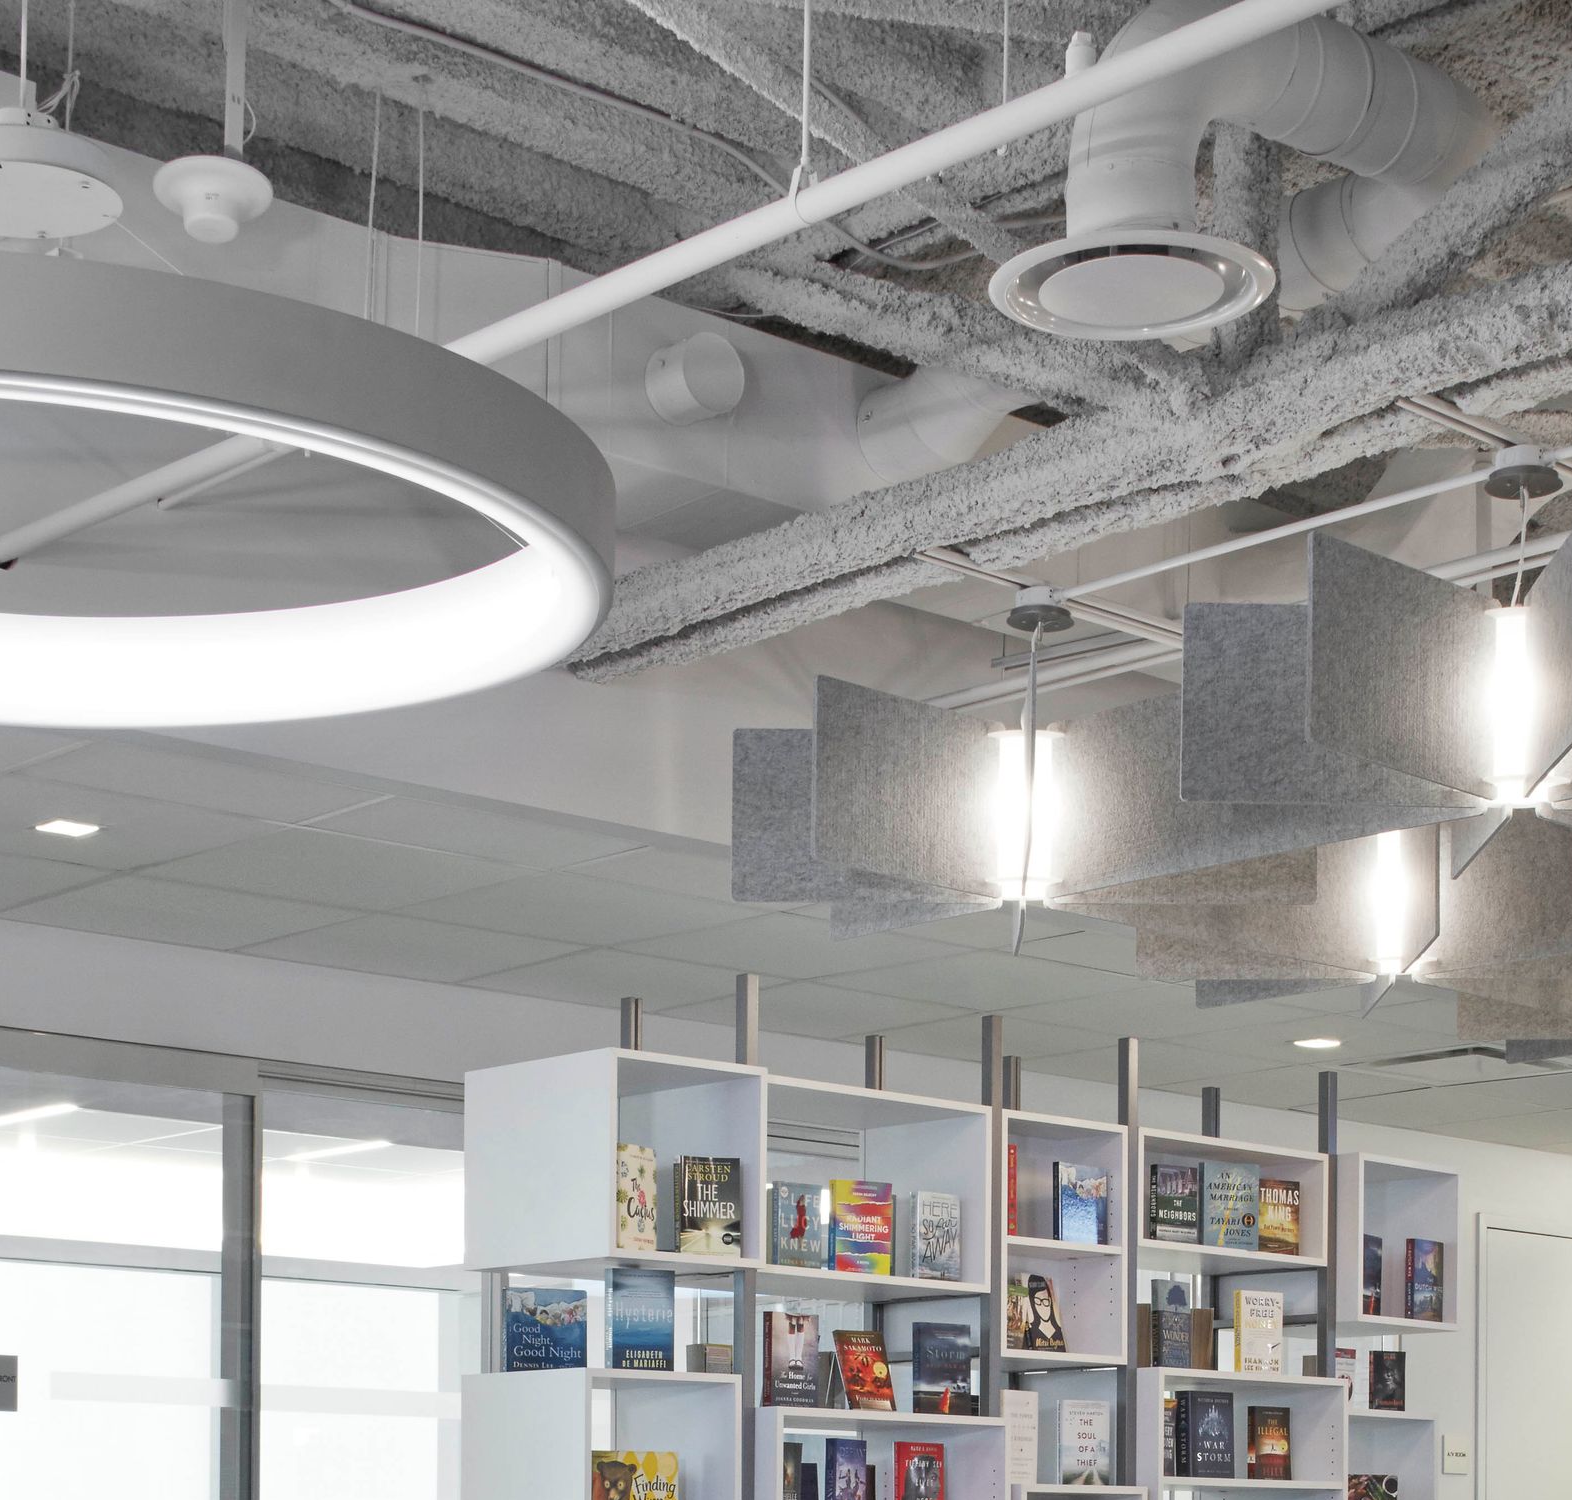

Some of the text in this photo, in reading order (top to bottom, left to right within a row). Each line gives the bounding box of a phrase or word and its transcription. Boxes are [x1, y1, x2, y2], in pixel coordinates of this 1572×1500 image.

[686, 1163, 731, 1174] CARSTEN
[687, 1172, 729, 1182] STROUD
[697, 1183, 718, 1201] THE
[1207, 1182, 1253, 1192] AMERICAN
[1210, 1193, 1254, 1203] MARRIAGE
[1260, 1187, 1300, 1206] THOMAS
[682, 1199, 735, 1219] SHIMMER
[922, 1200, 958, 1220] HERE
[1267, 1204, 1292, 1222] KING
[846, 1215, 883, 1224] RADIANT
[1158, 1209, 1197, 1222] NEIGHBORS
[1210, 1217, 1241, 1226] TAYARI
[838, 1222, 889, 1234] SHIMMERING
[1224, 1228, 1252, 1238] JONES
[851, 1232, 877, 1241] LIGHT
[780, 1236, 821, 1252] KNEW
[922, 1228, 959, 1264] AWAY
[1249, 1309, 1274, 1319] FREE
[513, 1322, 541, 1334] Good
[522, 1334, 554, 1347] Night,
[1163, 1329, 1189, 1342] WONDER
[513, 1345, 582, 1361] Good Night
[625, 1350, 663, 1360] ELISABETH
[788, 1370, 806, 1380] Home
[774, 1379, 802, 1390] Unwanted
[1079, 1418, 1094, 1427] THE
[1077, 1432, 1097, 1440] SOUL
[1257, 1426, 1289, 1436] ILLEGAL
[1078, 1445, 1089, 1453] OF
[1203, 1441, 1226, 1449] WAR
[1076, 1459, 1098, 1467] THIEF
[1196, 1452, 1232, 1463] STORM
[634, 1473, 677, 1499] Finding
